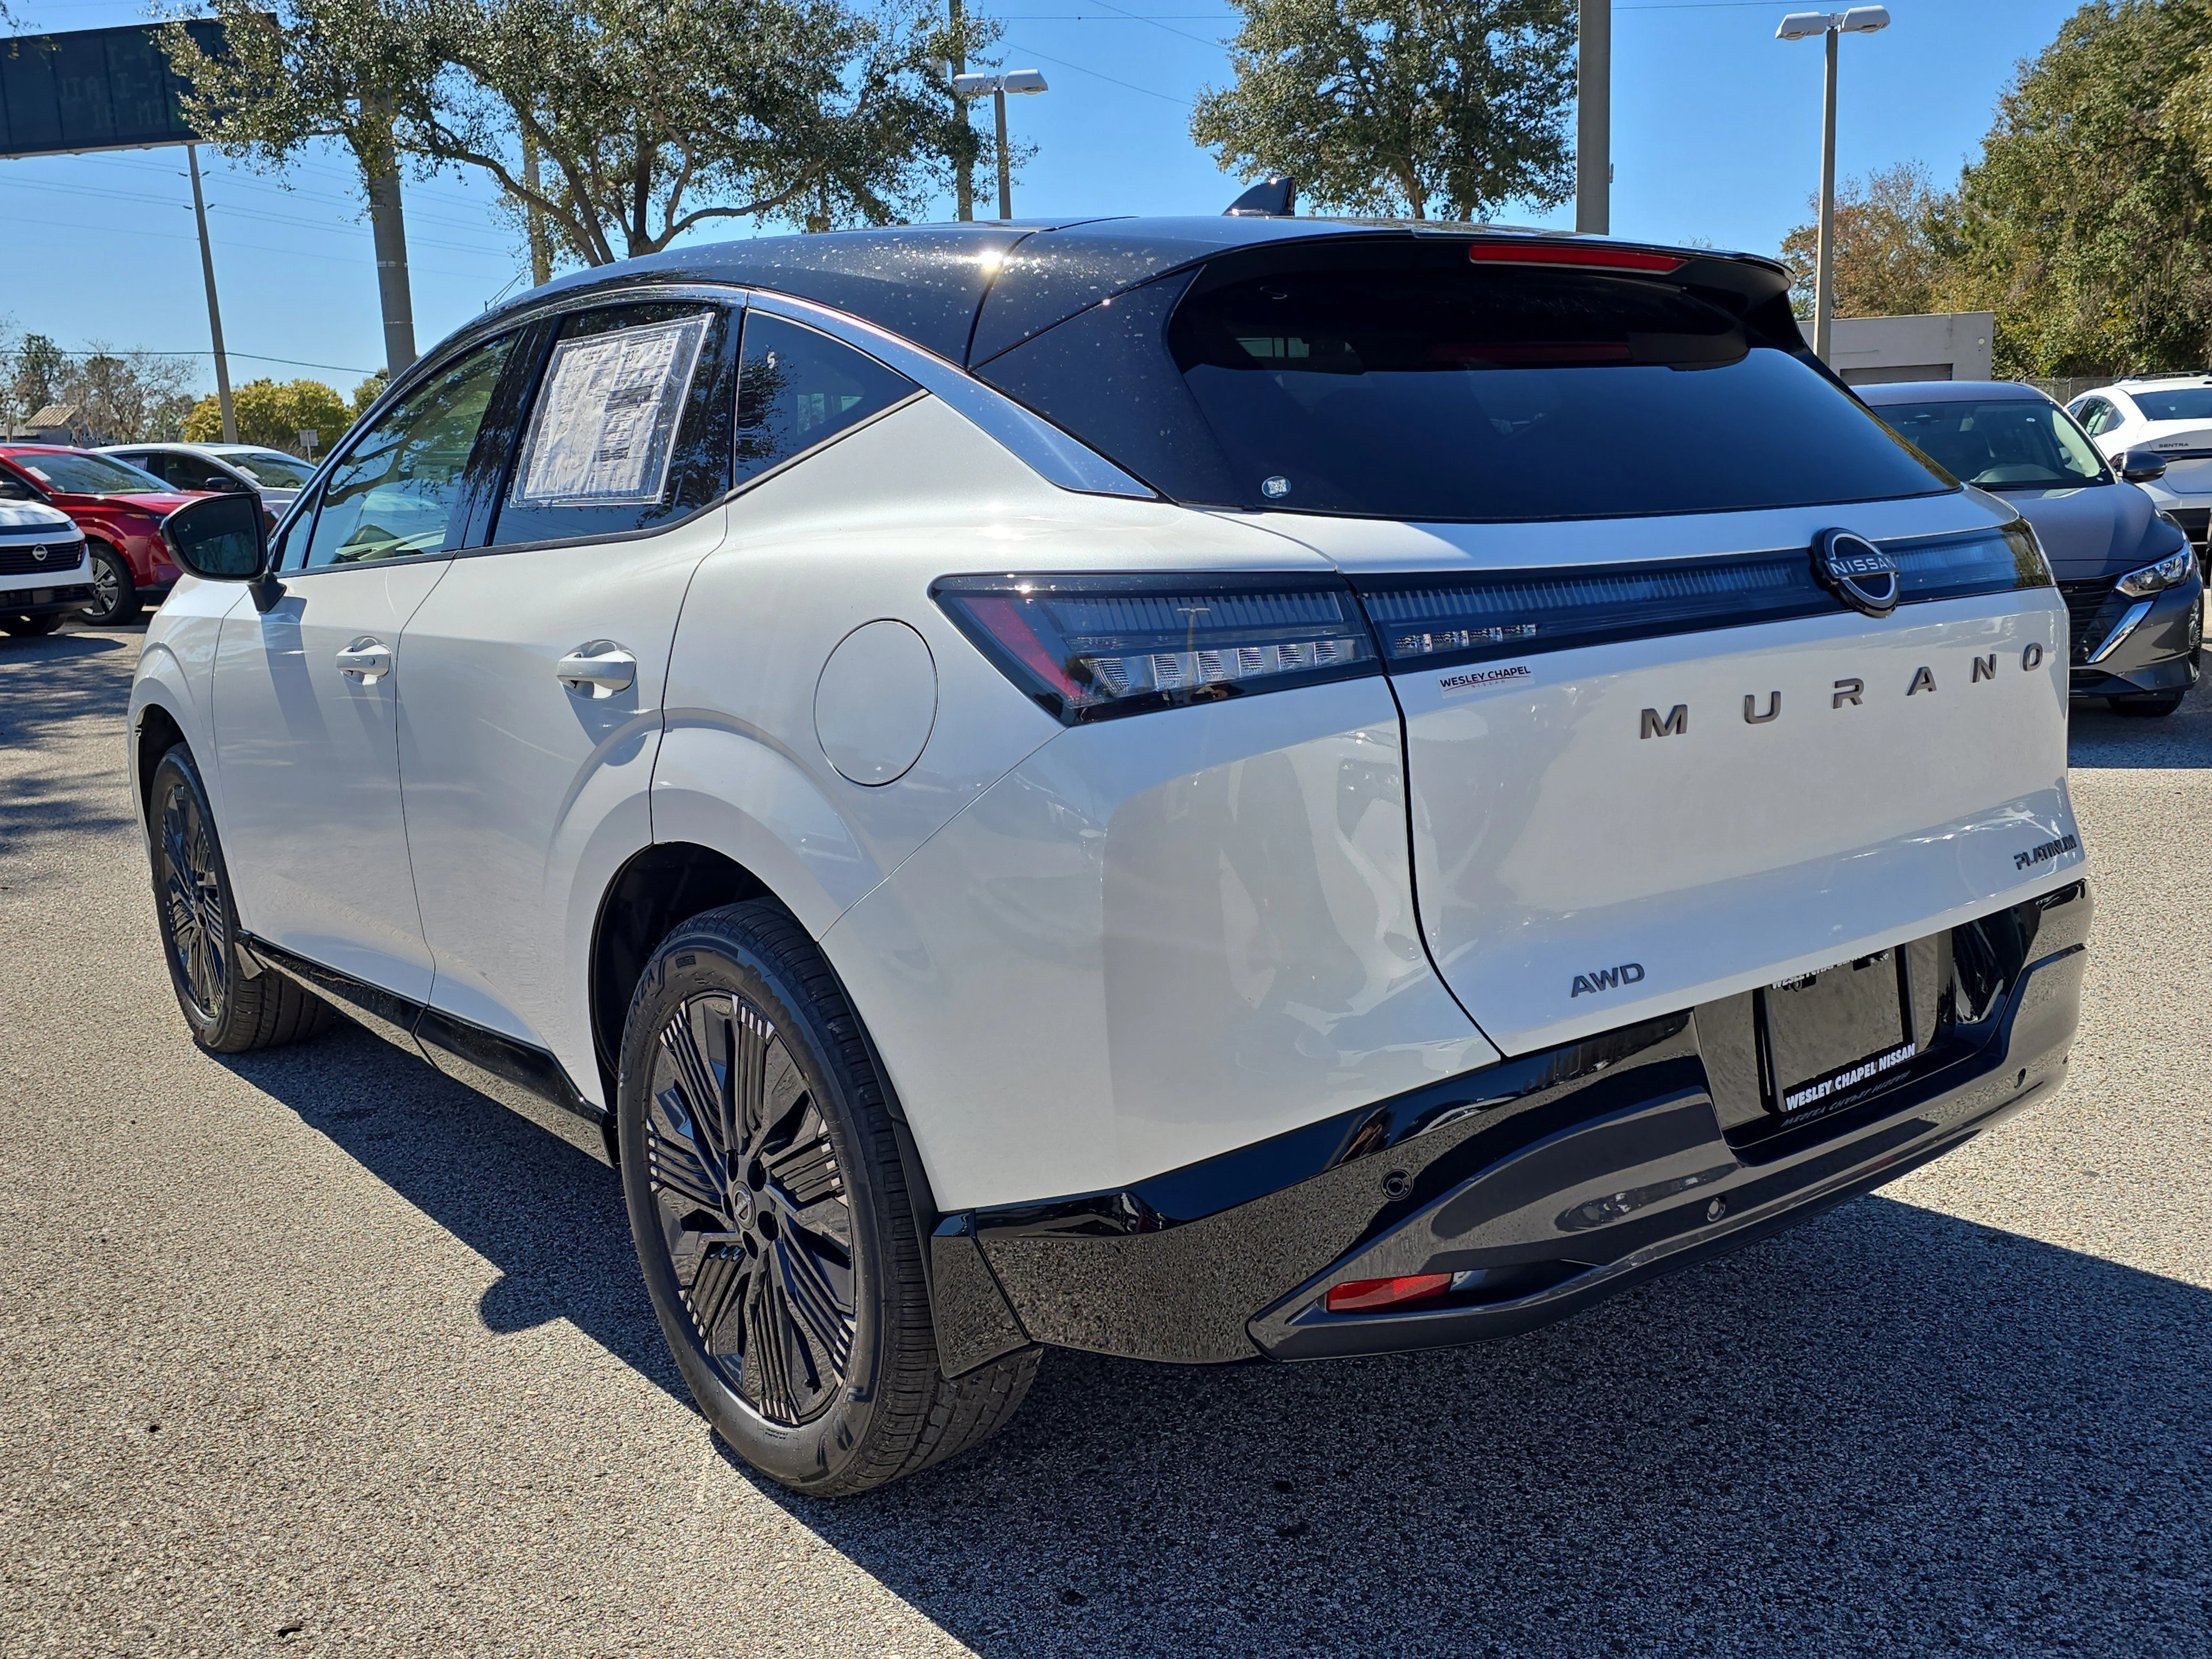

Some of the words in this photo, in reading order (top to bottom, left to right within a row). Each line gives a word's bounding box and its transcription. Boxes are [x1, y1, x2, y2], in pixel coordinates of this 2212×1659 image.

[1830, 557, 1896, 575] NISSAN
[1440, 672, 1484, 687] WESLEY
[1488, 666, 1531, 679] CHAPEL
[1639, 642, 2043, 740] MURANO
[2014, 834, 2078, 870] PLATINUM
[1571, 963, 1645, 998] AWD
[1786, 1079, 1832, 1110] WESLEY
[1835, 1061, 1876, 1090] CHAPEL
[1879, 1043, 1915, 1072] NISSAN
